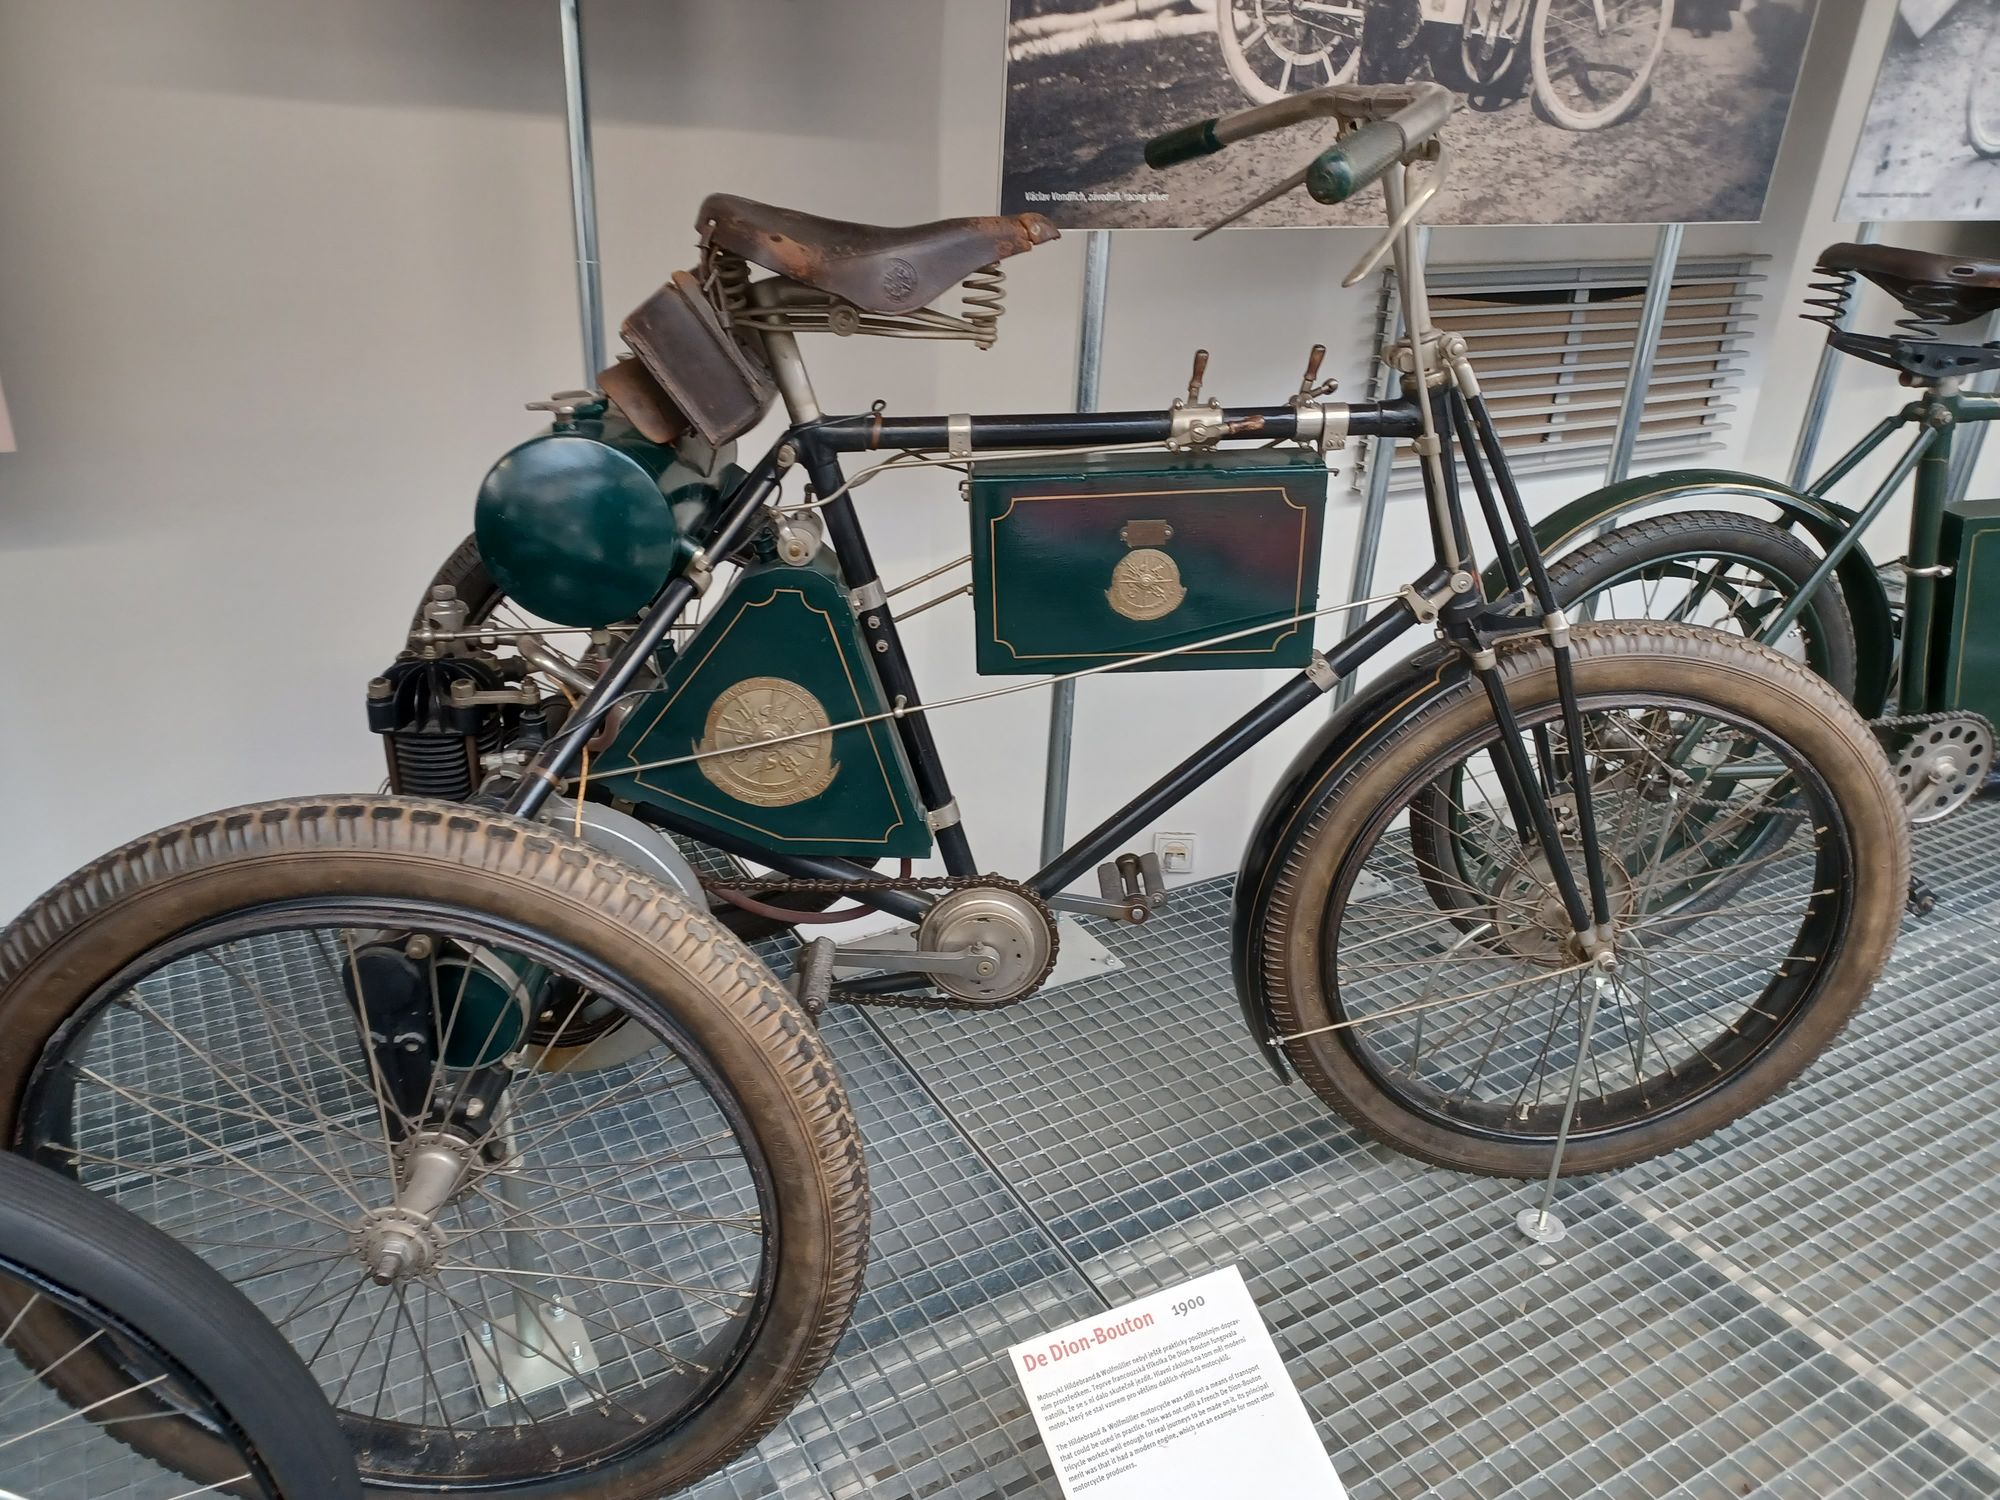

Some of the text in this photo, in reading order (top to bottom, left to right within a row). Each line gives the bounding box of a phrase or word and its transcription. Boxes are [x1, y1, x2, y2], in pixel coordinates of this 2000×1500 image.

[1147, 191, 1169, 201] driver
[1022, 1295, 1205, 1372] De Dion-Bouton 1900
[1036, 1386, 1064, 1401] Motocykl
[1063, 1373, 1096, 1391] Hildebrand
[1100, 1360, 1131, 1376] Wolfmüller
[1132, 1353, 1148, 1364] nebyl
[1147, 1347, 1162, 1359] ještě
[1162, 1339, 1187, 1353] prakticky
[1052, 1388, 1092, 1408] prostředkem.
[1091, 1380, 1112, 1391] Teprve
[1111, 1364, 1146, 1383] francouzská
[1176, 1340, 1211, 1358] Dion-Bouton
[1210, 1330, 1237, 1344] fungovala
[1044, 1408, 1068, 1422] natolik,
[1095, 1391, 1109, 1401] dalo
[1109, 1380, 1135, 1396] skutečně
[1134, 1374, 1153, 1386] jezdit.
[1152, 1365, 1172, 1378] Hlavní
[1201, 1350, 1213, 1359] tom
[1213, 1345, 1224, 1354] měl
[1224, 1336, 1246, 1350] moderní
[1048, 1420, 1069, 1431] motor,
[1068, 1411, 1084, 1423] který
[1092, 1403, 1104, 1414] stal
[1104, 1396, 1126, 1408] vzorem
[1126, 1392, 1137, 1401] pro
[1158, 1374, 1179, 1387] dalších
[1056, 1443, 1068, 1451] The
[1068, 1428, 1101, 1447] Hildebrand
[1107, 1413, 1139, 1430] Wolfmüller
[1140, 1400, 1171, 1417] motorcycle
[1170, 1396, 1183, 1404] was
[1183, 1389, 1195, 1400] still
[1194, 1386, 1205, 1395] not
[1209, 1377, 1228, 1389] means
[1228, 1373, 1234, 1381] of
[1234, 1364, 1260, 1379] transport
[1059, 1452, 1073, 1462] that
[1073, 1444, 1090, 1456] could
[1099, 1434, 1114, 1445] used
[1121, 1423, 1147, 1438] practice.
[1146, 1416, 1160, 1425] This
[1159, 1411, 1172, 1420] was
[1172, 1406, 1183, 1415] not
[1182, 1400, 1196, 1411] until
[1200, 1391, 1220, 1403] French
[1227, 1375, 1262, 1392] Dion-Bouton
[1063, 1459, 1086, 1472] tricycle
[1086, 1448, 1109, 1463] worked
[1109, 1442, 1123, 1453] well
[1122, 1434, 1145, 1447] enough
[1144, 1430, 1154, 1438] for
[1154, 1424, 1166, 1434] real
[1165, 1415, 1191, 1431] journeys
[1206, 1402, 1222, 1413] made
[1245, 1381, 1269, 1397] principal
[1068, 1471, 1085, 1482] merit
[1084, 1466, 1098, 1475] was
[1097, 1460, 1111, 1470] that
[1116, 1451, 1129, 1462] had
[1133, 1441, 1156, 1454] modern
[1156, 1433, 1179, 1447] engine,
[1178, 1424, 1196, 1436] which
[1195, 1420, 1206, 1428] set
[1213, 1407, 1237, 1421] example
[1246, 1397, 1260, 1407] most
[1260, 1391, 1275, 1401] other
[1072, 1462, 1137, 1493] motorcycle producers.
